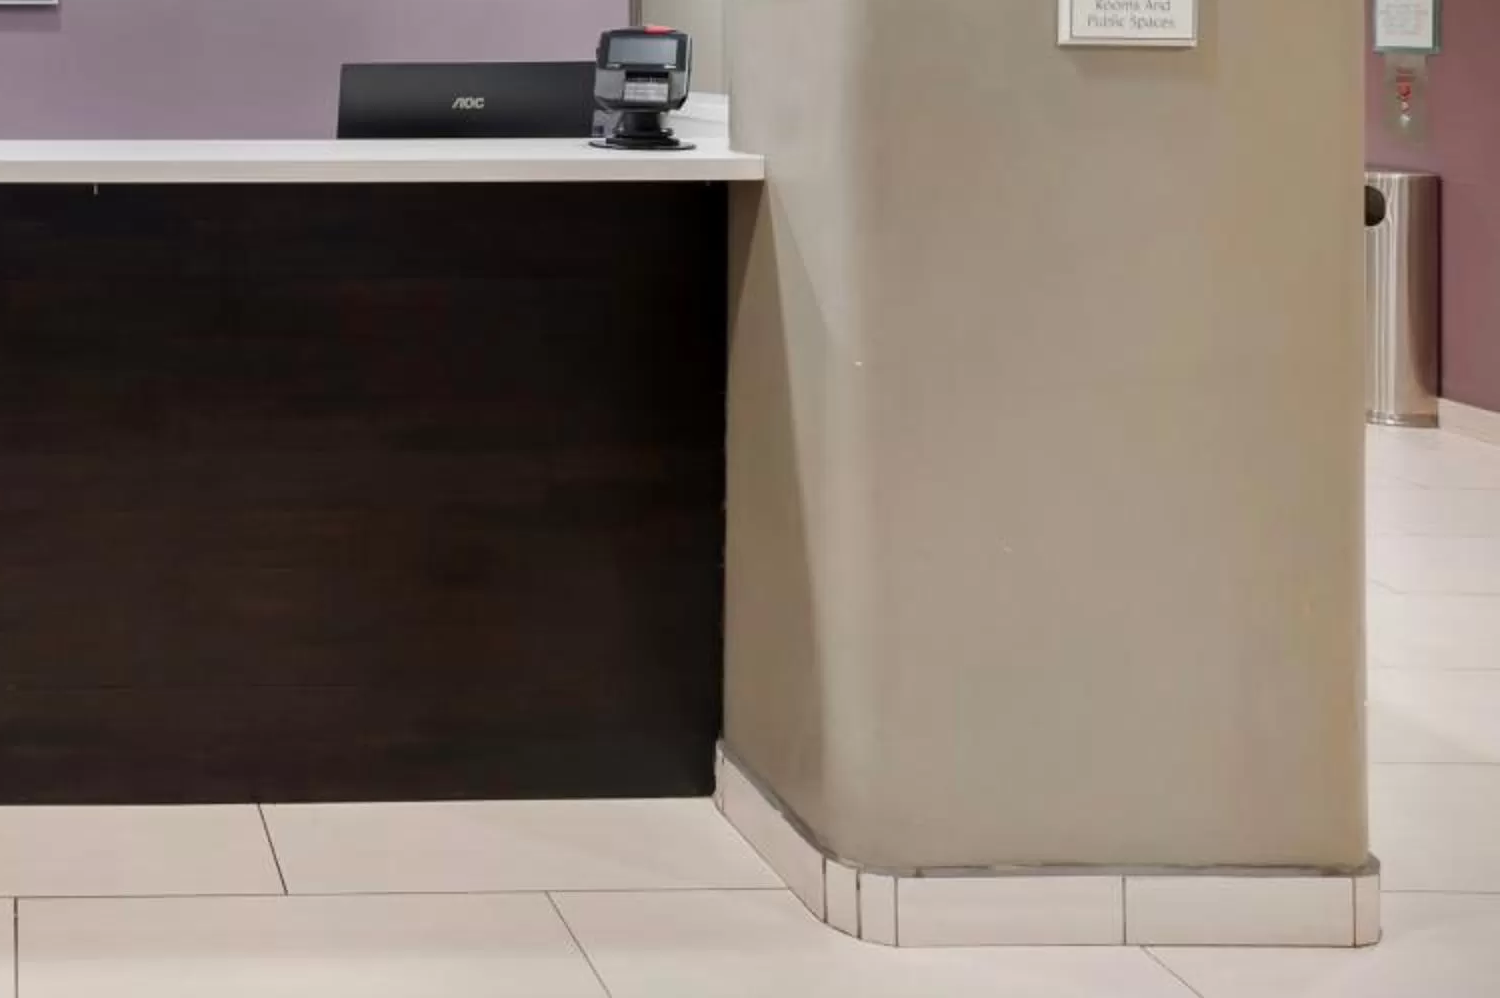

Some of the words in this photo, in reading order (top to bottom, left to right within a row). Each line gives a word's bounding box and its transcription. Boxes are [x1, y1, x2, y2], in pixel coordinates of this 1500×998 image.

[1087, 13, 1123, 26] Public
[1129, 14, 1176, 29] Spaces
[451, 97, 485, 109] AOC
